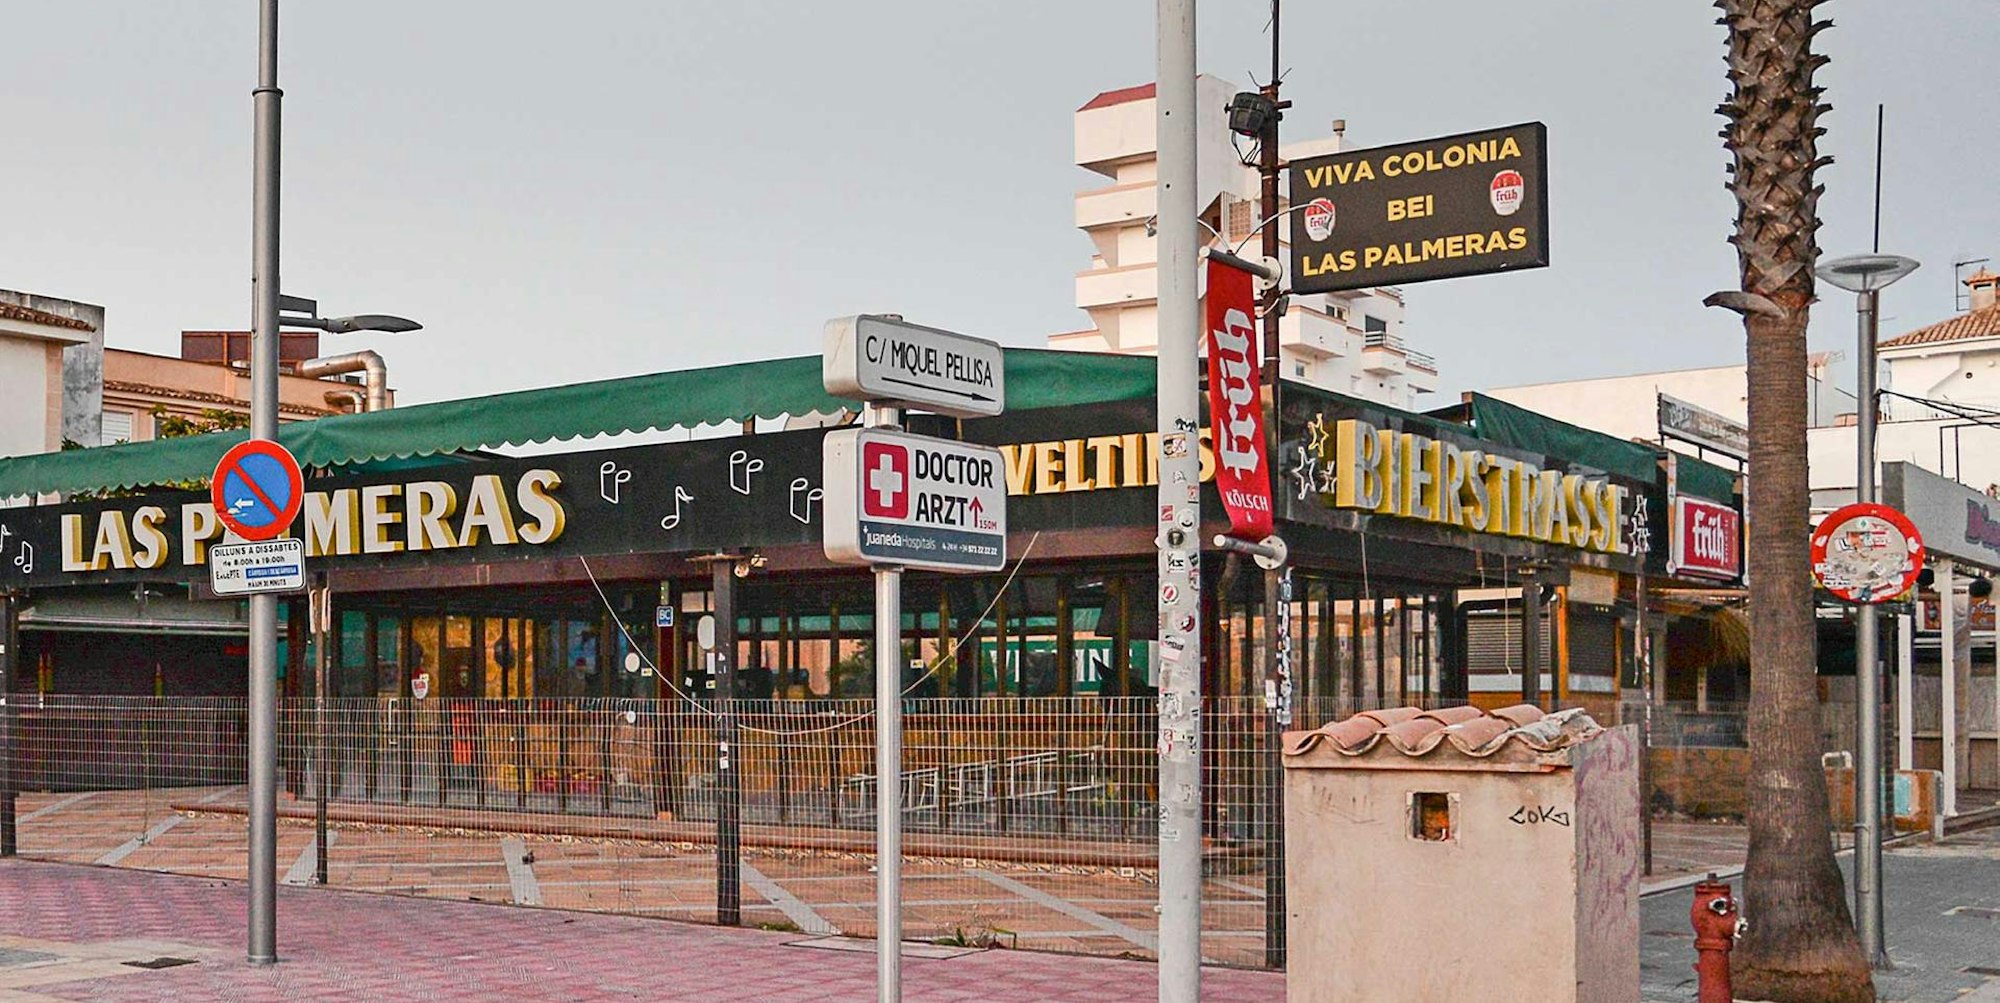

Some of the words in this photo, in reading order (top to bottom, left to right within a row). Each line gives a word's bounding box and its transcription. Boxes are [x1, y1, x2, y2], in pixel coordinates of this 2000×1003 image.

[1305, 161, 1375, 188] VIVA
[1383, 137, 1521, 177] COLONIA
[1387, 195, 1433, 221] BEI
[1302, 251, 1356, 276] LAS
[1365, 227, 1527, 268] PALMERAS
[866, 335, 887, 364] C/
[892, 340, 941, 376] MIQUEL
[946, 352, 994, 388] PELLISA
[1214, 308, 1260, 480] früh
[915, 450, 993, 488] DOCTOR
[999, 427, 1217, 496] VELTIS
[915, 492, 968, 526] ARZT
[1225, 490, 1269, 512] KÖLSCH
[1336, 419, 1630, 555] BIERSTRASSE
[61, 506, 168, 571] LAS
[182, 469, 566, 566] PMERAS
[866, 533, 901, 547] juaneda
[903, 534, 936, 550] Hospitals
[979, 520, 997, 530] 150M
[1692, 508, 1724, 566] früh
[215, 547, 246, 557] DILLUNS
[249, 546, 254, 554] A
[256, 543, 298, 554] DISSABTES
